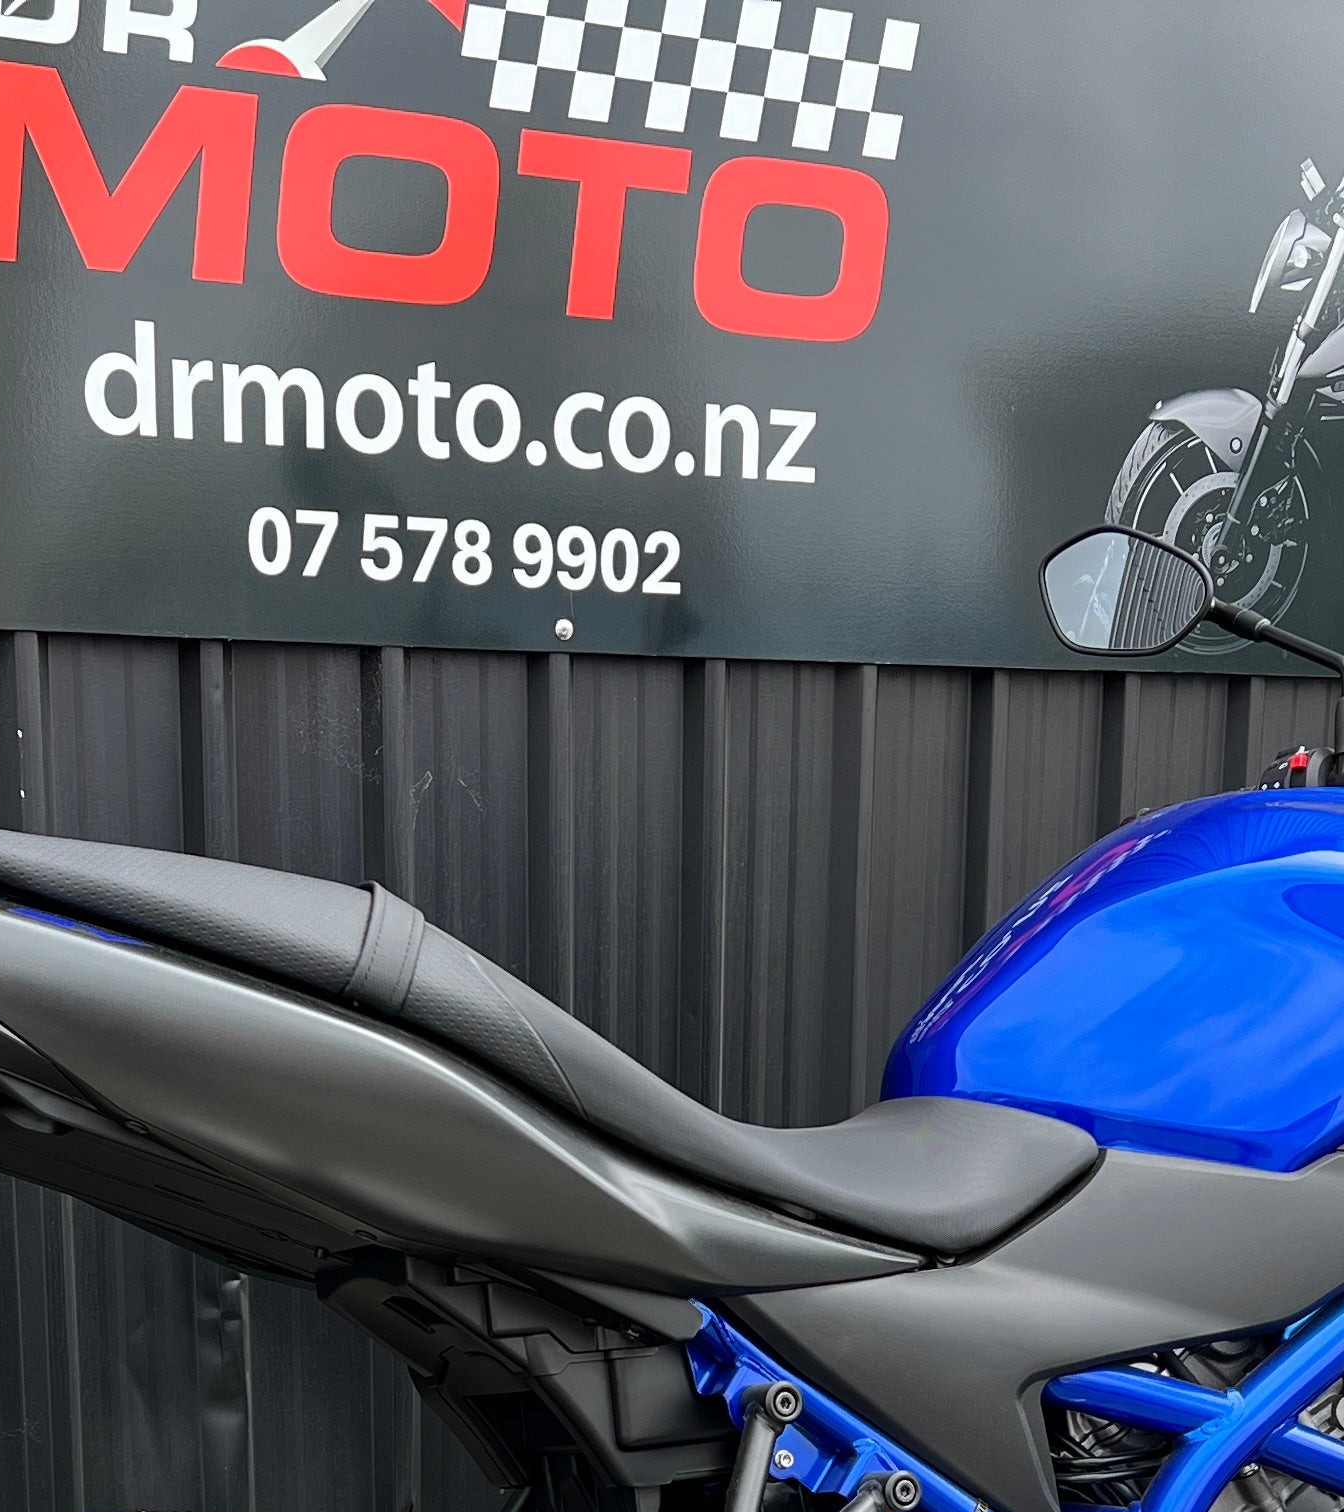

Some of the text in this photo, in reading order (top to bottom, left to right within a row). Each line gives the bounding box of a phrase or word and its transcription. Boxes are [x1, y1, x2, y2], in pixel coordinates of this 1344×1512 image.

[84, 319, 818, 484] drmoto.co.nz
[248, 507, 681, 595] 07 578 9902
